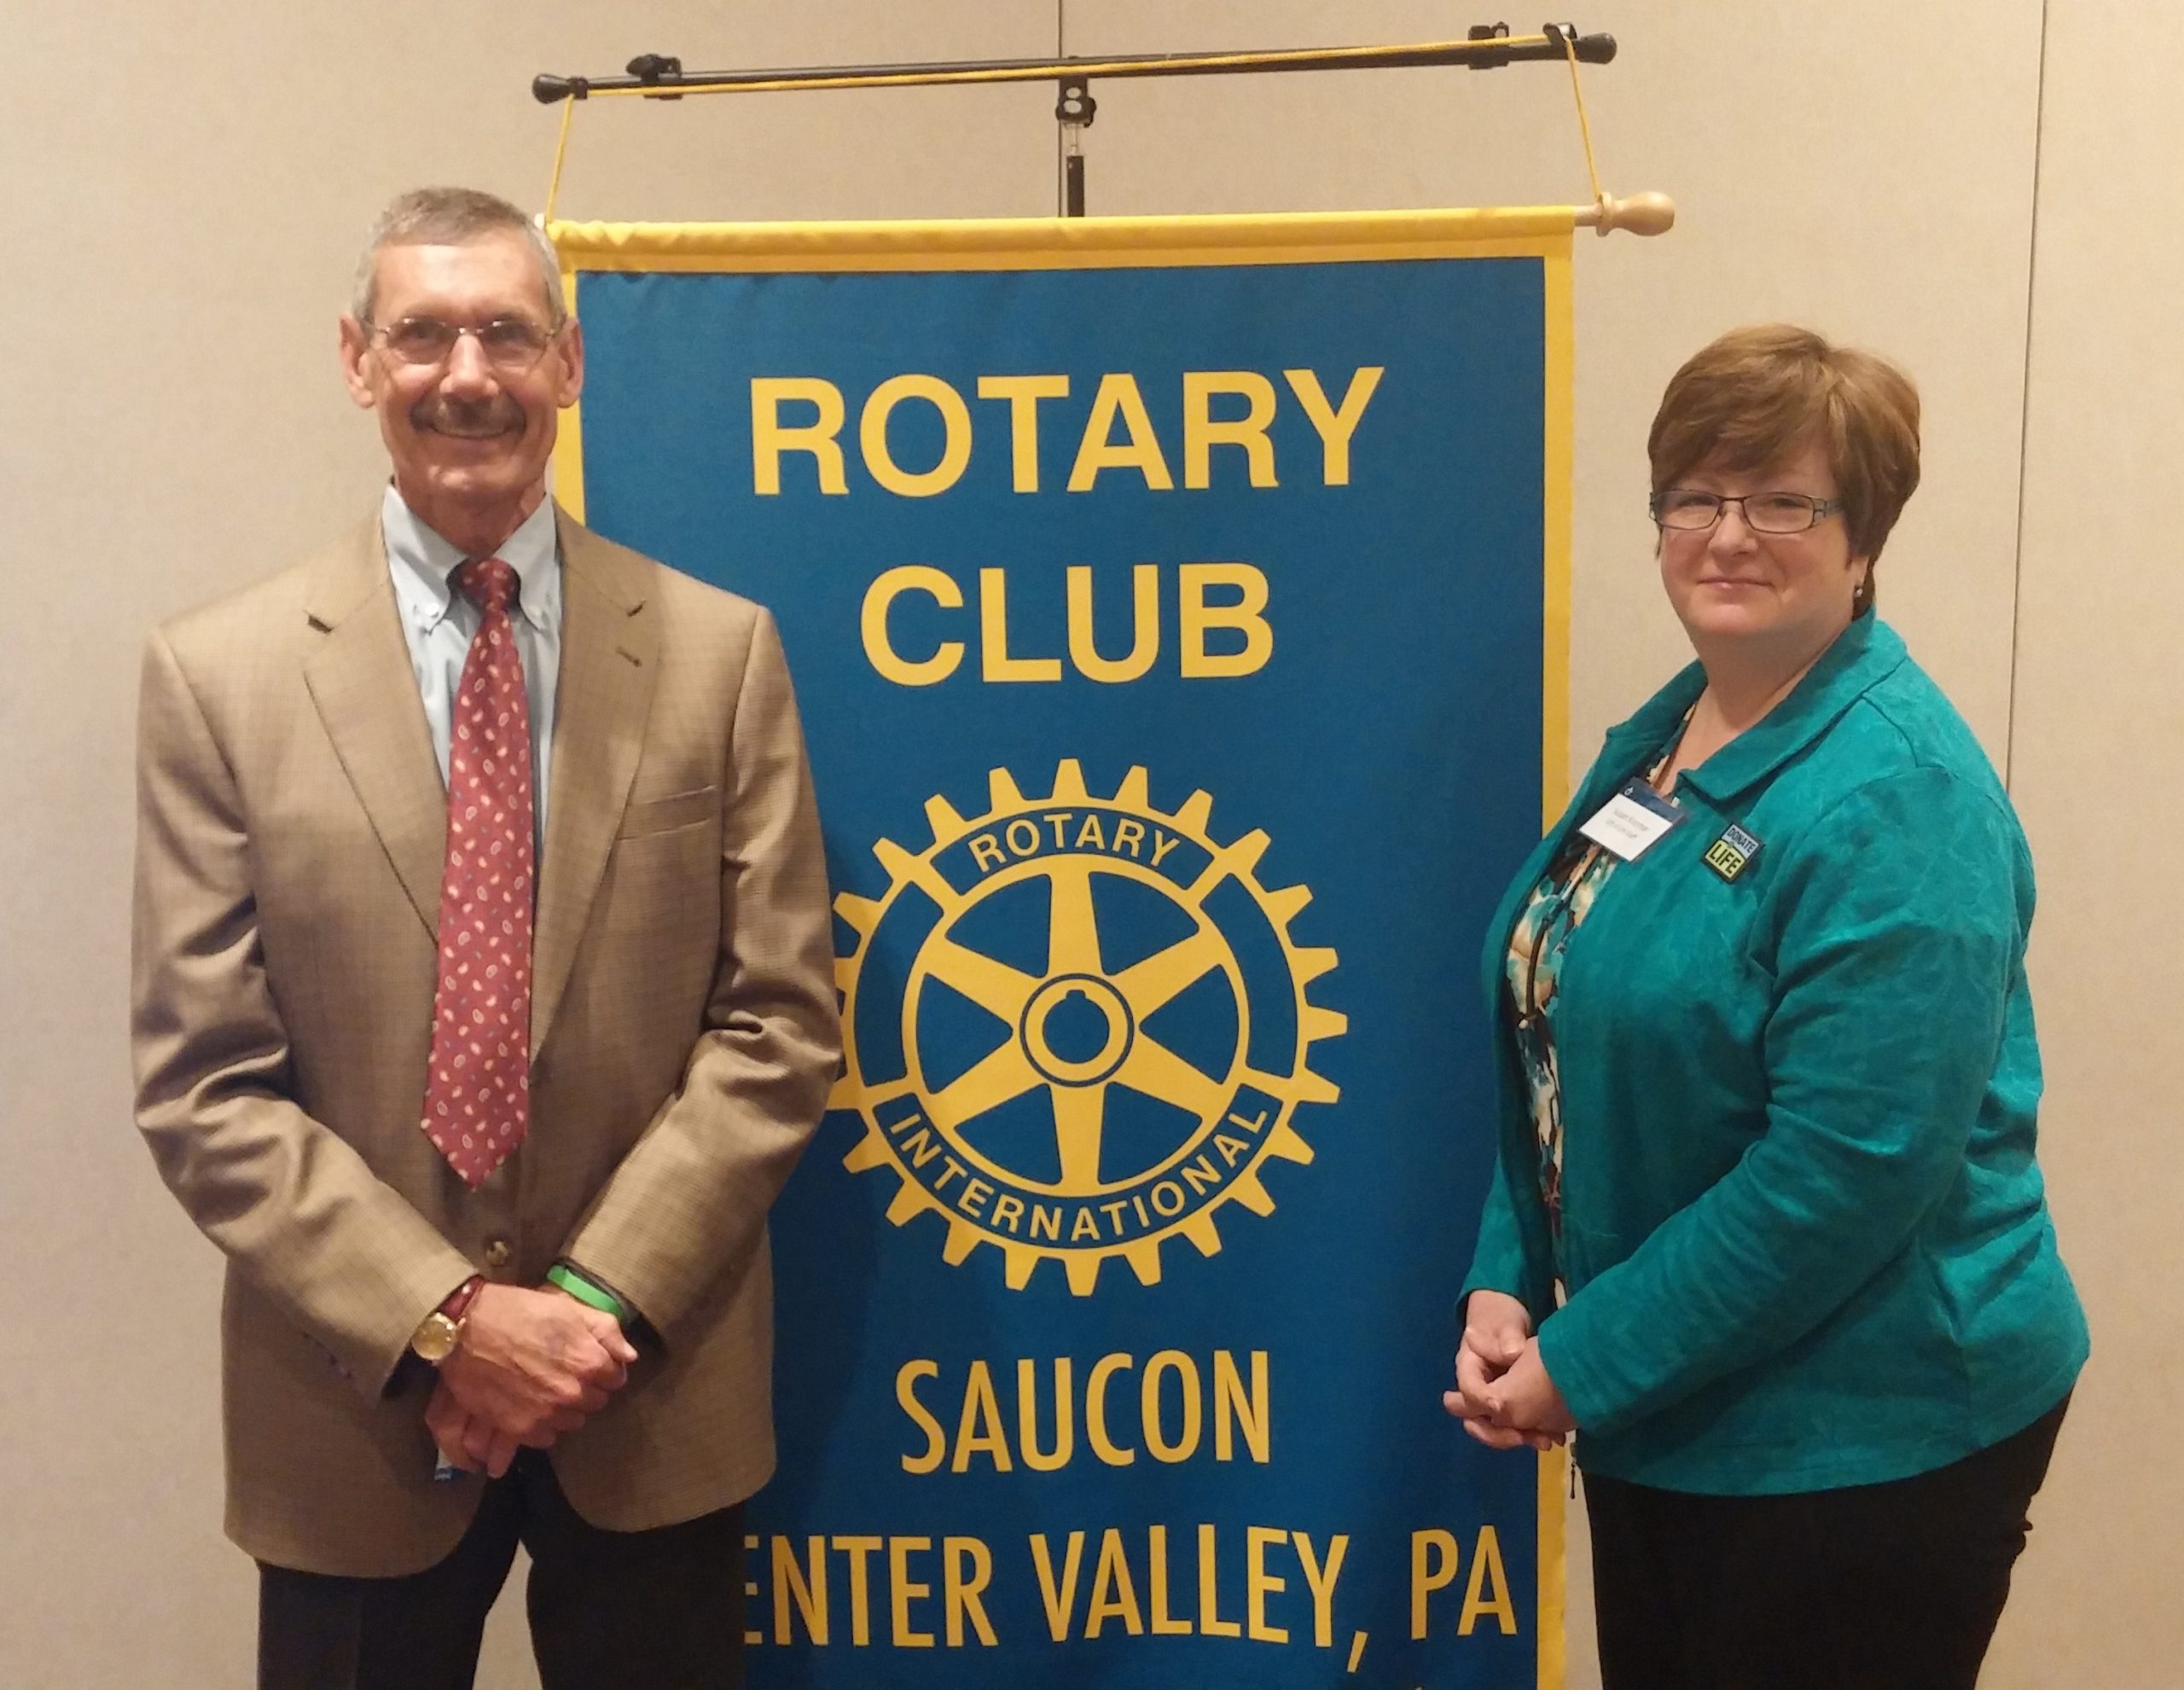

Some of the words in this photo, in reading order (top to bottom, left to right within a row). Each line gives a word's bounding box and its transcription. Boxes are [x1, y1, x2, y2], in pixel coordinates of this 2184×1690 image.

[750, 366, 1385, 497] ROTARY
[860, 562, 1275, 686] CLUB
[967, 812, 1182, 874] ROTARY
[1708, 843, 1742, 874] LIFE
[1726, 827, 1757, 854] DONATE
[888, 1110, 1268, 1242] INTERNATIONAL
[897, 1350, 1270, 1473] SAUCON
[1029, 1524, 1368, 1673] VALLEY,
[1411, 1525, 1518, 1639] PA
